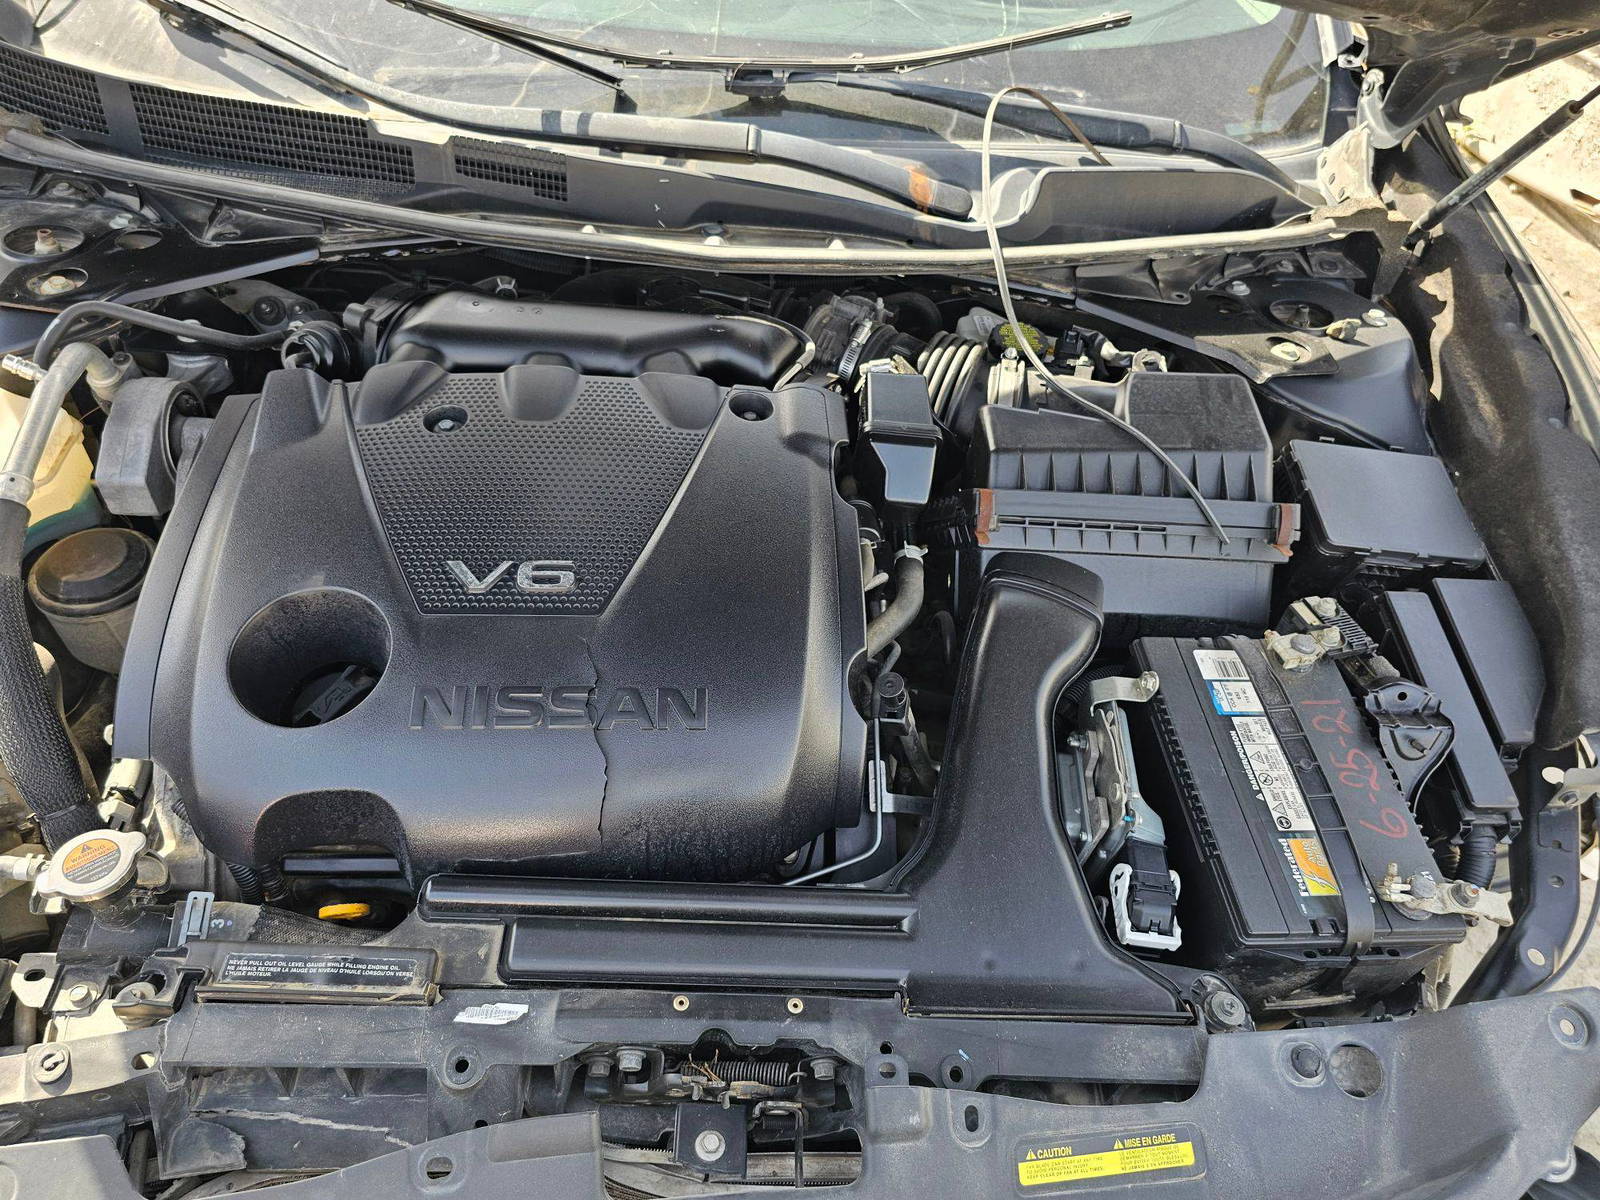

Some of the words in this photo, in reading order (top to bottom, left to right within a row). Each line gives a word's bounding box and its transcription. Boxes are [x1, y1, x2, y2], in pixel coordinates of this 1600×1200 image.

[446, 560, 577, 594] V6
[410, 685, 708, 731] NISSAN
[1277, 839, 1310, 896] Federated
[1037, 1146, 1073, 1159] CAUTION
[1124, 1137, 1141, 1148] MISE
[1141, 1136, 1152, 1146] EN
[1152, 1133, 1177, 1145] GARDE
